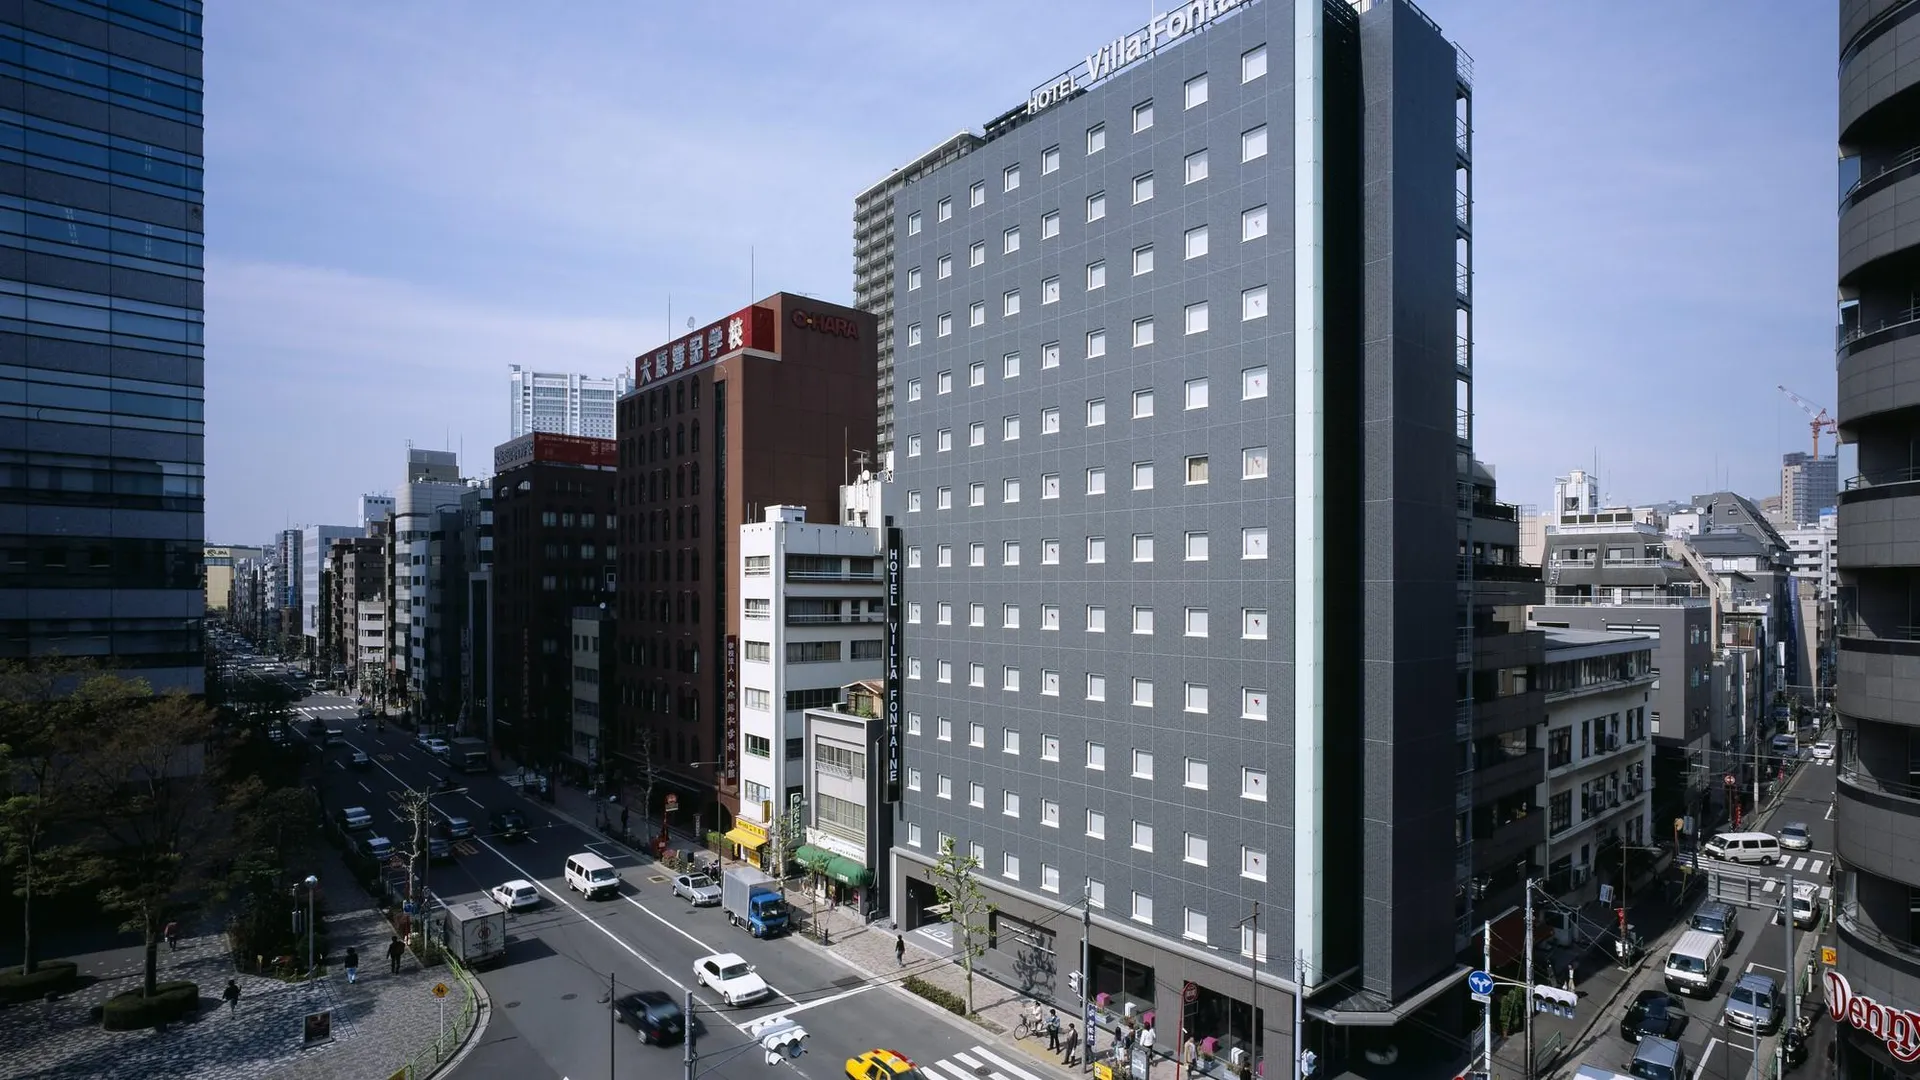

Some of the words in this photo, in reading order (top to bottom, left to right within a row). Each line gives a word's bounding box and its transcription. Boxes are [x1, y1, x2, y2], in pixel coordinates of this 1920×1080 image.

[1027, 74, 1082, 115] HOTEL
[1085, 34, 1142, 82] Villa
[889, 549, 898, 606] HOTEL
[889, 622, 898, 680] VILLA
[889, 690, 898, 782] FONTAINE
